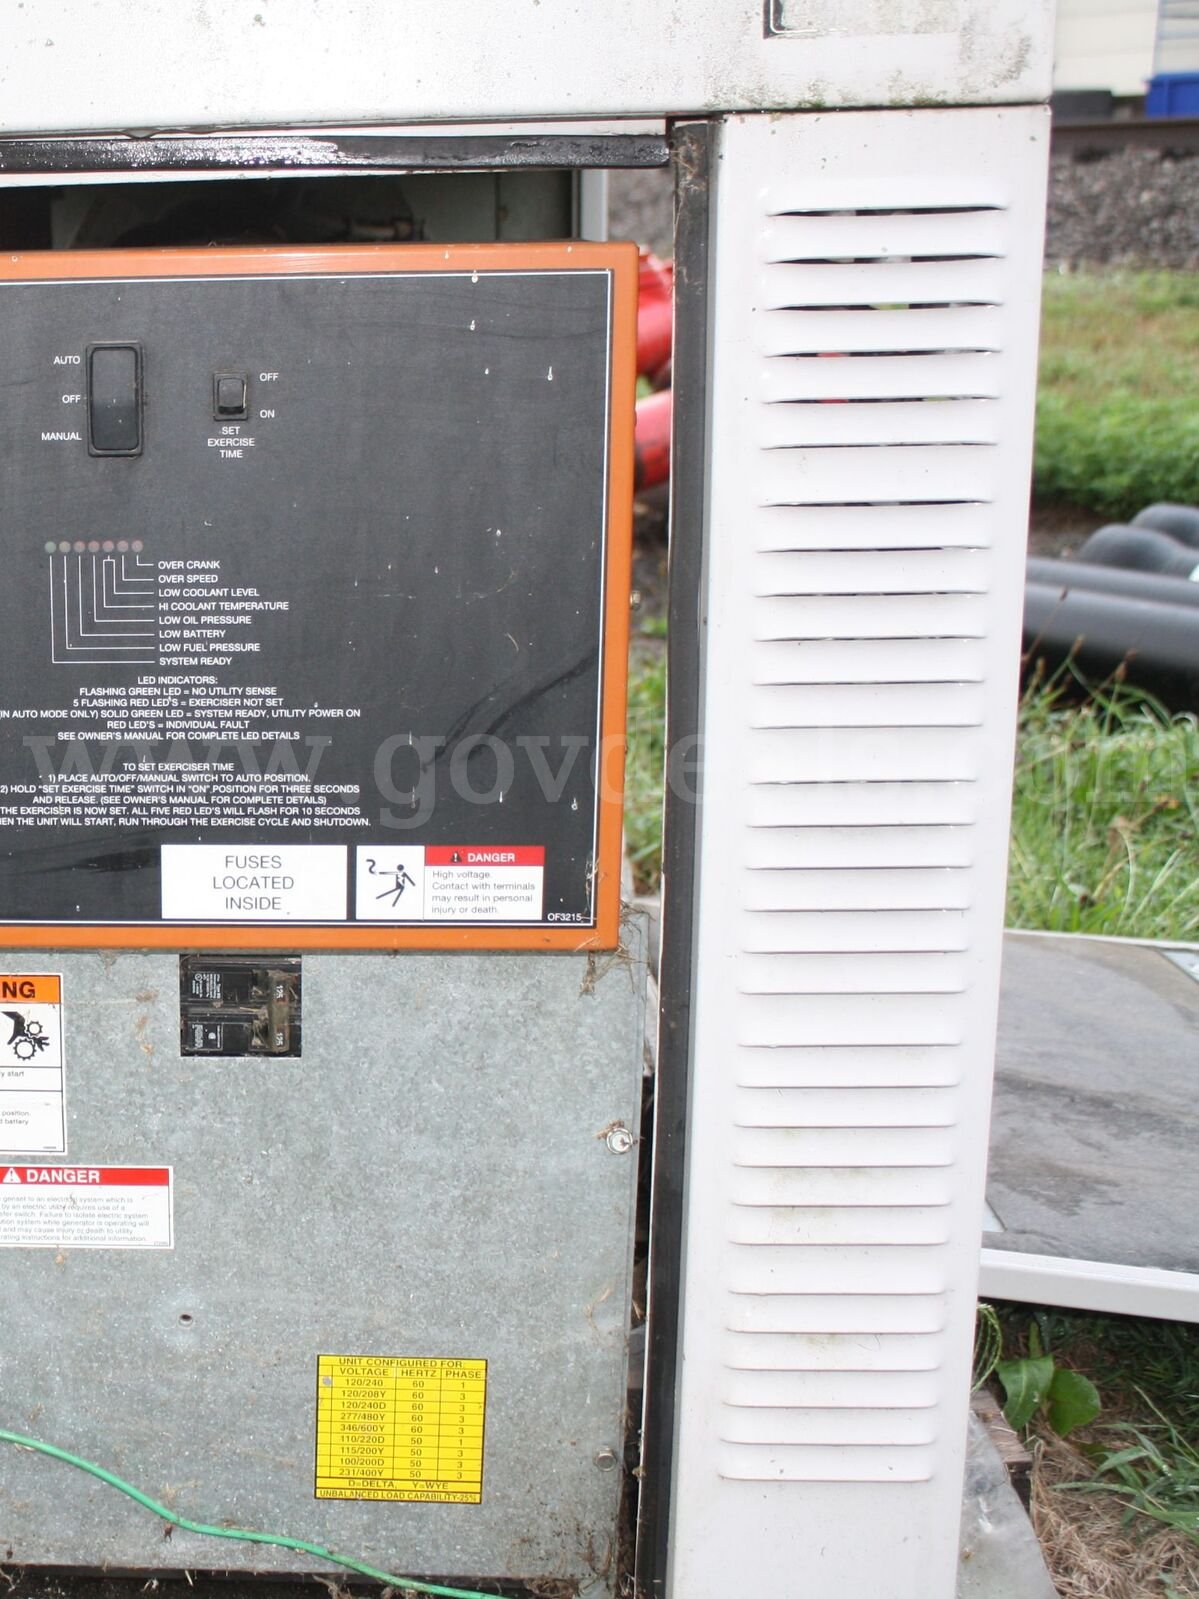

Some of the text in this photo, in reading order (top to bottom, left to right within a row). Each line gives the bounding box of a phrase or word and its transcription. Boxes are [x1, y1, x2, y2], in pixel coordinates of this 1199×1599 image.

[53, 356, 81, 364] AUTO
[259, 373, 279, 381] OFF
[61, 395, 81, 403] OFF
[259, 410, 275, 418] ON
[221, 427, 241, 435] SET
[41, 432, 82, 440] MANUAL
[207, 438, 255, 446] EXERCISE
[219, 450, 244, 458] TIME
[157, 561, 221, 569] OVER CRANK
[157, 575, 219, 583] OVER SPEED
[158, 588, 260, 597] LOW COOLANT LEVEL
[158, 602, 289, 611] HI COOLANT TEMPERATURE
[158, 616, 252, 624] LOW OIL PRESSURE
[158, 630, 226, 638] LOW BATTERY
[159, 643, 261, 652] LOW FUEL PRESSURE
[159, 657, 233, 665] SYSTEM READY
[137, 676, 218, 684] LED INDICATORS:
[79, 688, 127, 696] FLASHING
[127, 688, 161, 696] GREEN
[162, 688, 182, 696] LED
[191, 687, 207, 695] NO
[208, 687, 244, 695] UTILITY
[245, 687, 277, 695] SENSE
[72, 699, 80, 707] 5
[80, 699, 128, 707] FLASHING
[129, 699, 150, 707] RED
[151, 698, 179, 706] LED'S
[188, 699, 242, 707] EXERCISER
[243, 698, 264, 706] NOT
[265, 698, 284, 706] SET
[106, 721, 127, 729] RED
[128, 721, 156, 729] LED'S
[165, 721, 219, 729] INDIVIDUAL
[219, 721, 250, 729] FAULT
[57, 732, 301, 740] SEE OWNER'S MANUAL FOR COMPLETE LED DETAILS
[122, 763, 235, 771] TO SET EXERCISER TIME
[47, 774, 311, 783] 1) PLACE AUTO/OFF/MANUAL SWITCH TO AUTO POSITION.
[15, 818, 35, 826] THE
[36, 818, 59, 826] UNIT
[59, 818, 83, 826] WILL
[84, 818, 117, 826] START,
[118, 818, 140, 826] RUN
[140, 818, 188, 826] THROUGH
[189, 818, 209, 826] THE
[210, 818, 256, 826] EXERCISE
[257, 818, 290, 826] CYCLE
[290, 818, 312, 826] AND
[313, 818, 372, 826] SHUTDOWN.
[225, 856, 282, 868] FUSES
[467, 853, 516, 862] DANGER
[432, 871, 491, 880] High voltage.
[212, 876, 295, 889] LOCATED
[432, 882, 536, 891] Contact with terminals
[225, 897, 281, 910] INSIDE
[432, 894, 533, 904] may result in personal
[431, 905, 499, 914] injury or death.
[547, 913, 583, 921] OF3215
[276, 984, 284, 999] 125
[276, 1032, 284, 1047] 125
[7, 1070, 24, 1078] start
[26, 1169, 100, 1184] DANGER
[366, 1359, 437, 1367] CONFIGURED
[340, 1367, 389, 1376] VOLTAGE
[445, 1370, 482, 1379] PHASE
[345, 1378, 383, 1387] 120/240
[342, 1390, 386, 1398] 120/208Y
[412, 1392, 424, 1400] 60
[341, 1401, 386, 1410] 120/240D
[411, 1403, 424, 1411] 60
[340, 1413, 386, 1421] 277/480Y
[411, 1415, 423, 1423] 60
[340, 1424, 385, 1432] 346/600Y
[410, 1426, 423, 1434] 60
[340, 1435, 385, 1444] 110/220D
[410, 1437, 422, 1445] 50
[340, 1447, 384, 1455] 115/200Y
[340, 1458, 385, 1466] 100/200D
[339, 1469, 383, 1477] 231/400Y
[320, 1490, 477, 1501] UNBALANCED LOAD CAPABILITY-25%
